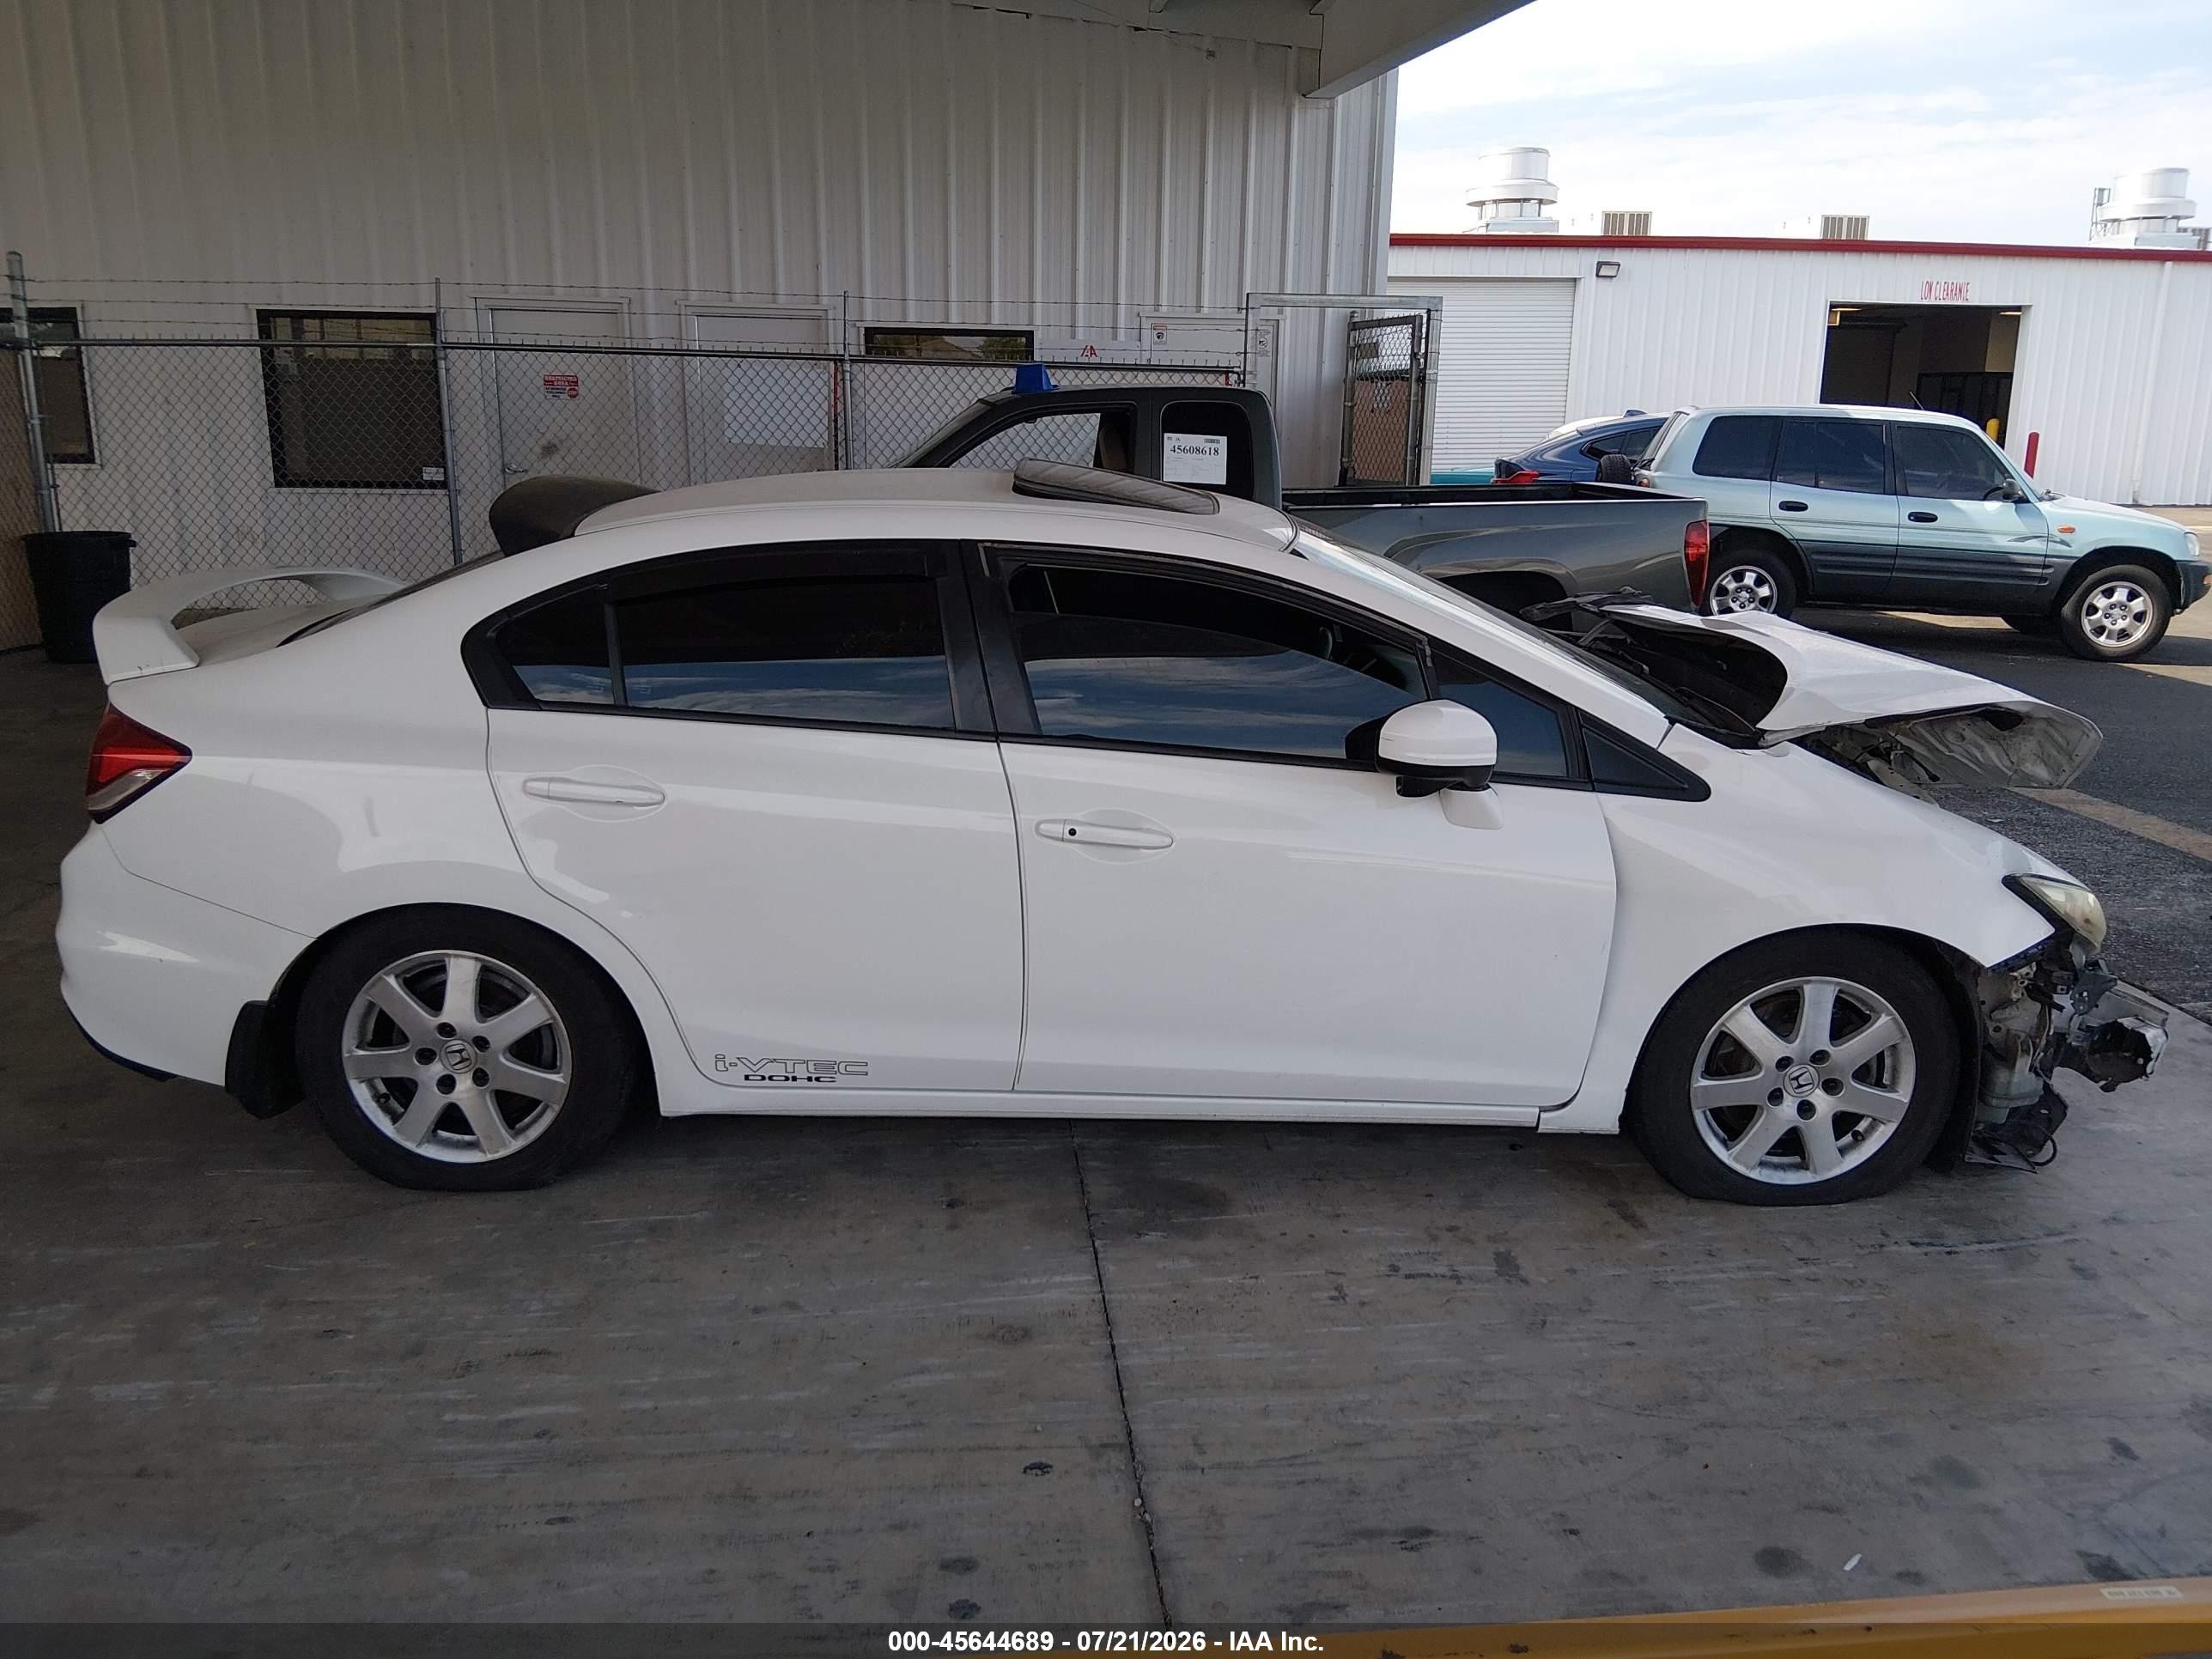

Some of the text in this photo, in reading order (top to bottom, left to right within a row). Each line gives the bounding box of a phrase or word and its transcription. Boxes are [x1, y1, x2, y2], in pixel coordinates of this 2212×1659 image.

[1170, 444, 1220, 457] 45608618
[714, 1054, 869, 1077] i-VTEC
[744, 1074, 836, 1083] DOHC
